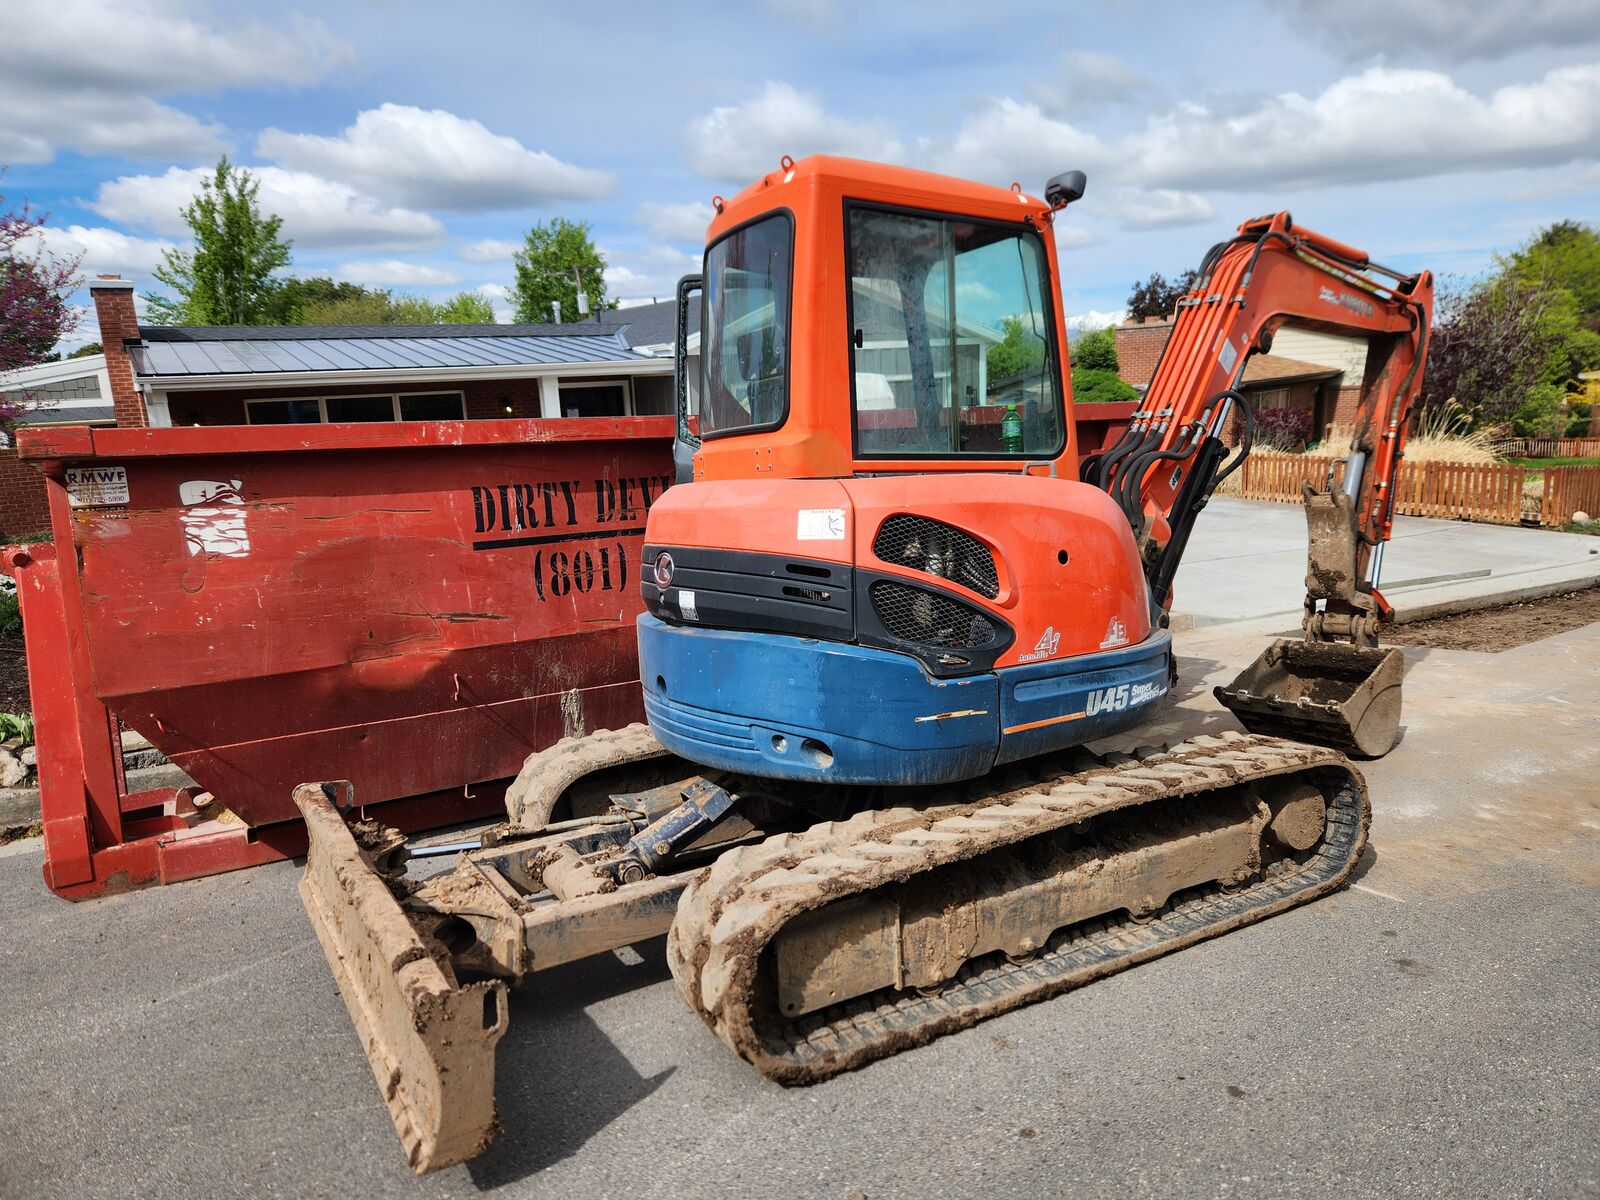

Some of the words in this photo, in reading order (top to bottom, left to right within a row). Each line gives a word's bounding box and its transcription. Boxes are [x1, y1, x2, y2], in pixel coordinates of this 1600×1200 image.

[67, 472, 125, 483] RMWF
[471, 480, 580, 533] DIRTY
[595, 475, 676, 522] DEV
[534, 543, 627, 602] (801)
[1086, 684, 1130, 717] U45
[1131, 682, 1153, 697] Super
